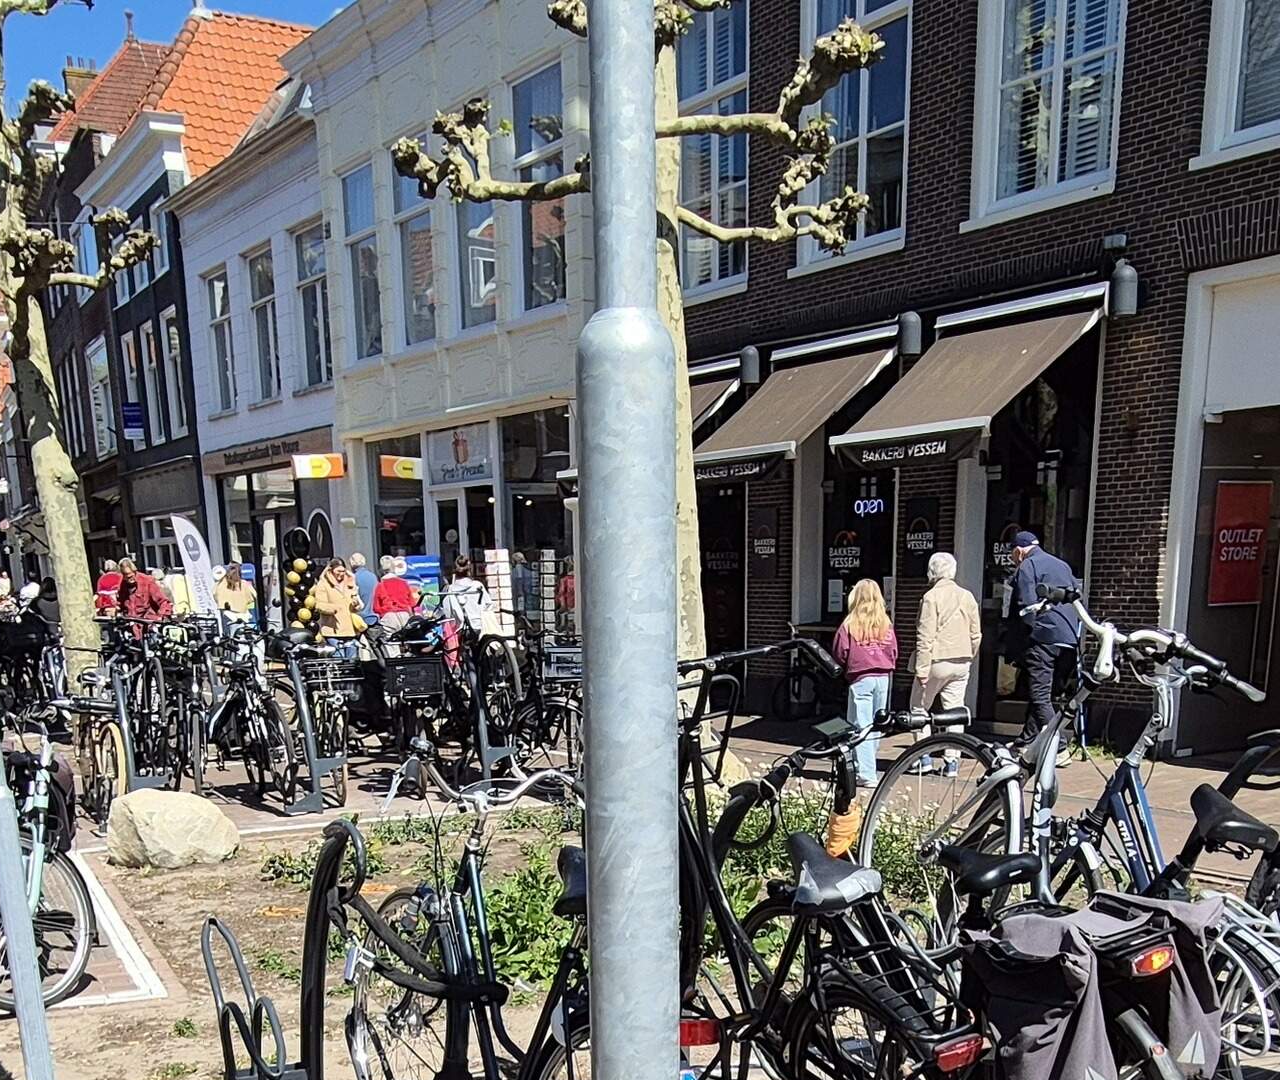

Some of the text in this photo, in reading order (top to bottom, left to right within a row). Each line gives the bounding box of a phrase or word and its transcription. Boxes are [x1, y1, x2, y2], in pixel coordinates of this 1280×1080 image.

[907, 440, 947, 457] VESSEM
[854, 498, 885, 518] open
[1219, 528, 1264, 544] OUTLET
[906, 541, 934, 550] VESSEM
[993, 554, 1013, 566] VES
[1220, 547, 1259, 562] STORE
[829, 557, 861, 568] VESSEM
